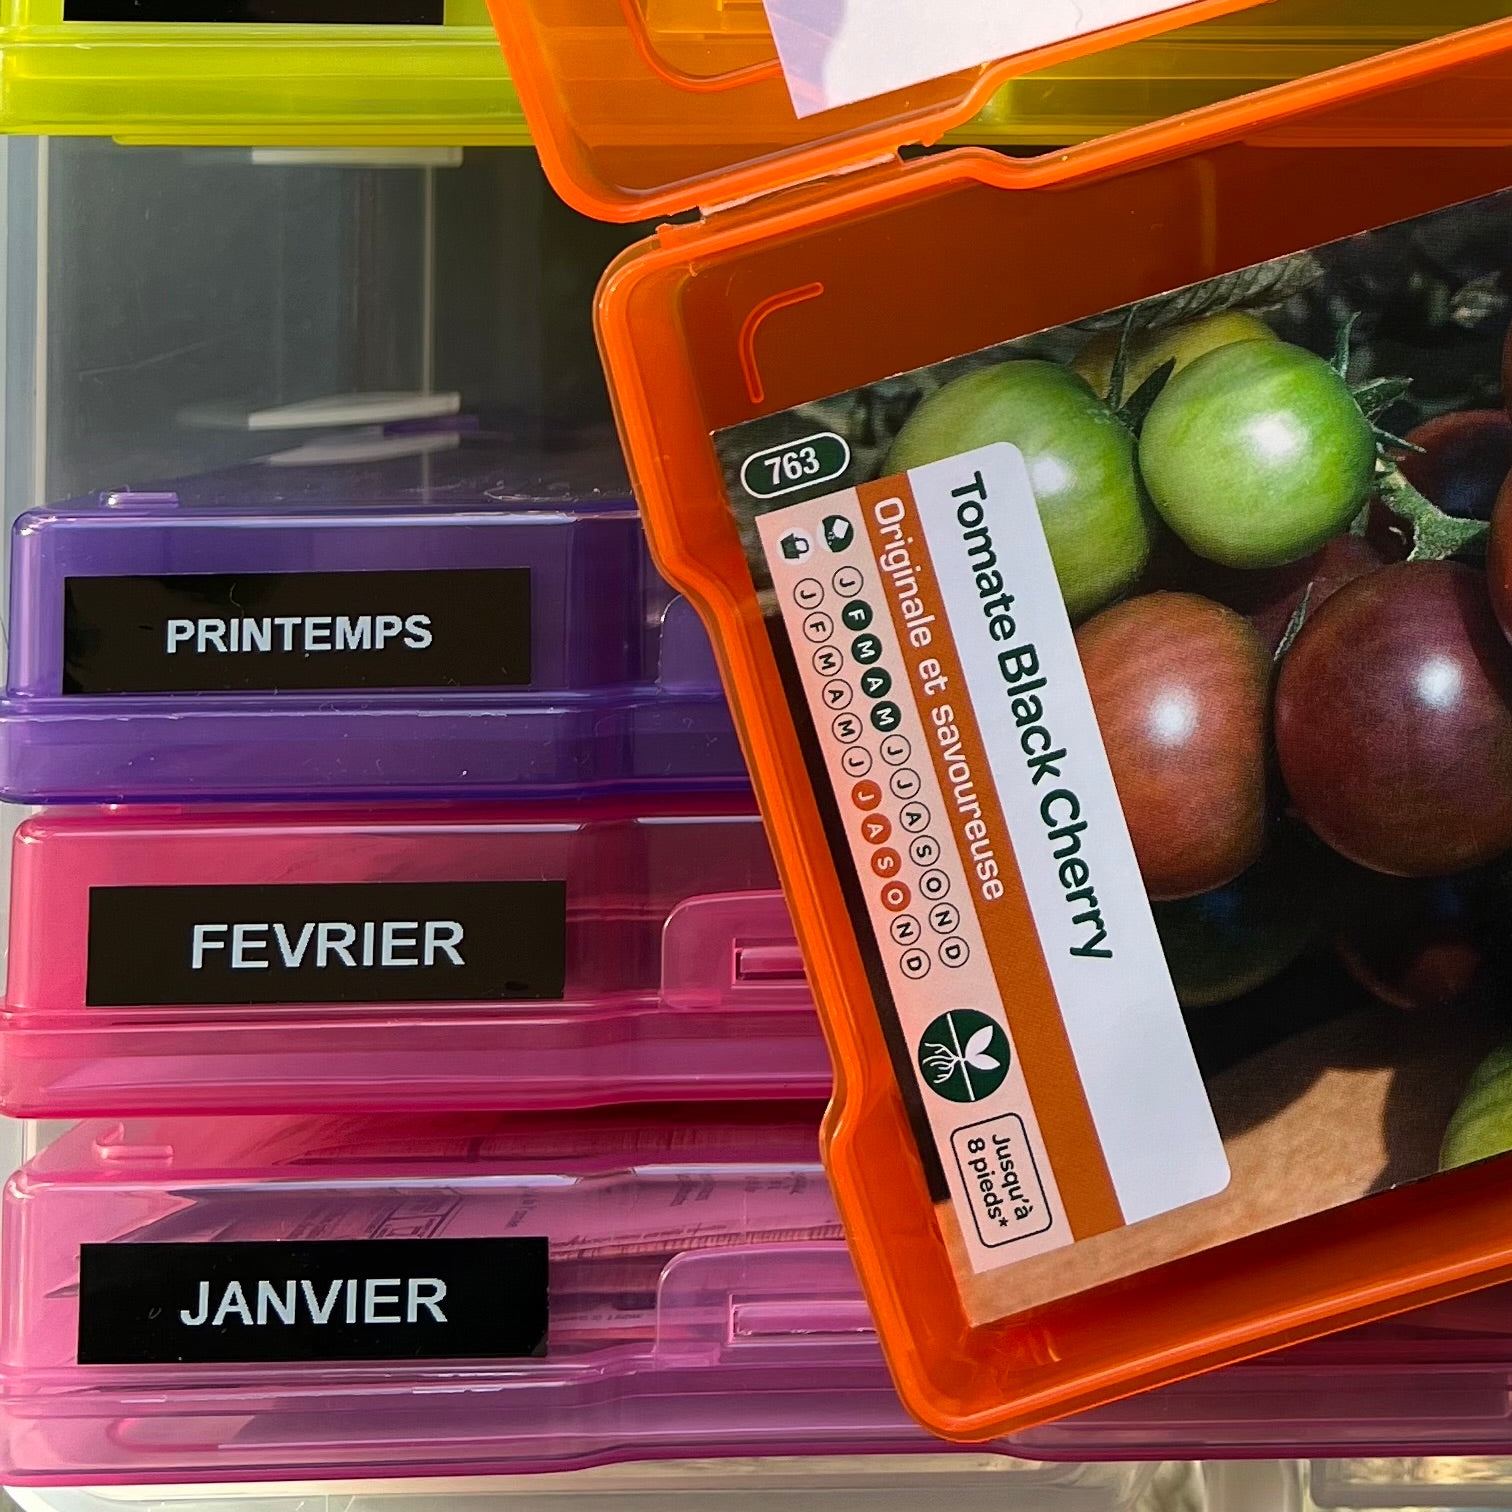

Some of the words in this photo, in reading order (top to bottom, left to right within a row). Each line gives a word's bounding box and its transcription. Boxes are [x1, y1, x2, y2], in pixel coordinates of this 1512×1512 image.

[763, 449, 820, 486] 763
[873, 496, 935, 647] Originale
[166, 614, 433, 654] PRINTEMPS
[918, 658, 948, 695] et
[950, 470, 1016, 641] Tomate
[997, 643, 1067, 785] Black
[1039, 788, 1113, 958] Cherry
[930, 704, 1004, 900] savoureuse
[191, 920, 466, 969] FEVRIER
[966, 1136, 985, 1154] 8
[991, 1133, 1033, 1220] Jusqu'à
[180, 1277, 449, 1326] JANVIER
